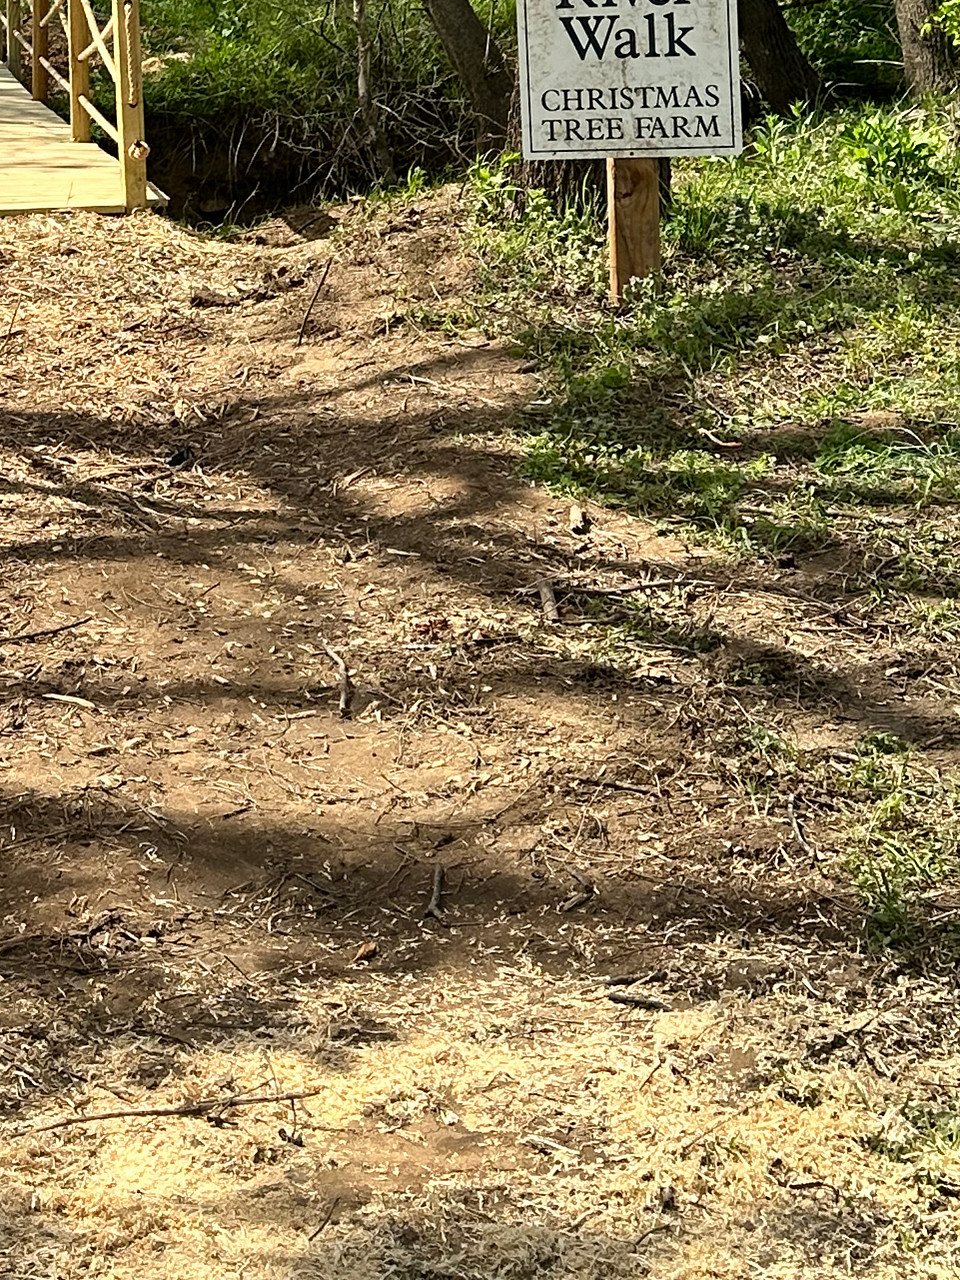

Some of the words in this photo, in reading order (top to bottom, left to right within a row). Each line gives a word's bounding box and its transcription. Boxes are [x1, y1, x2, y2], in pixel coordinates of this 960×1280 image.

[558, 11, 697, 61] Walk
[540, 84, 721, 112] CHRISTMAS
[541, 117, 625, 142] TREE
[634, 114, 723, 140] FARM
